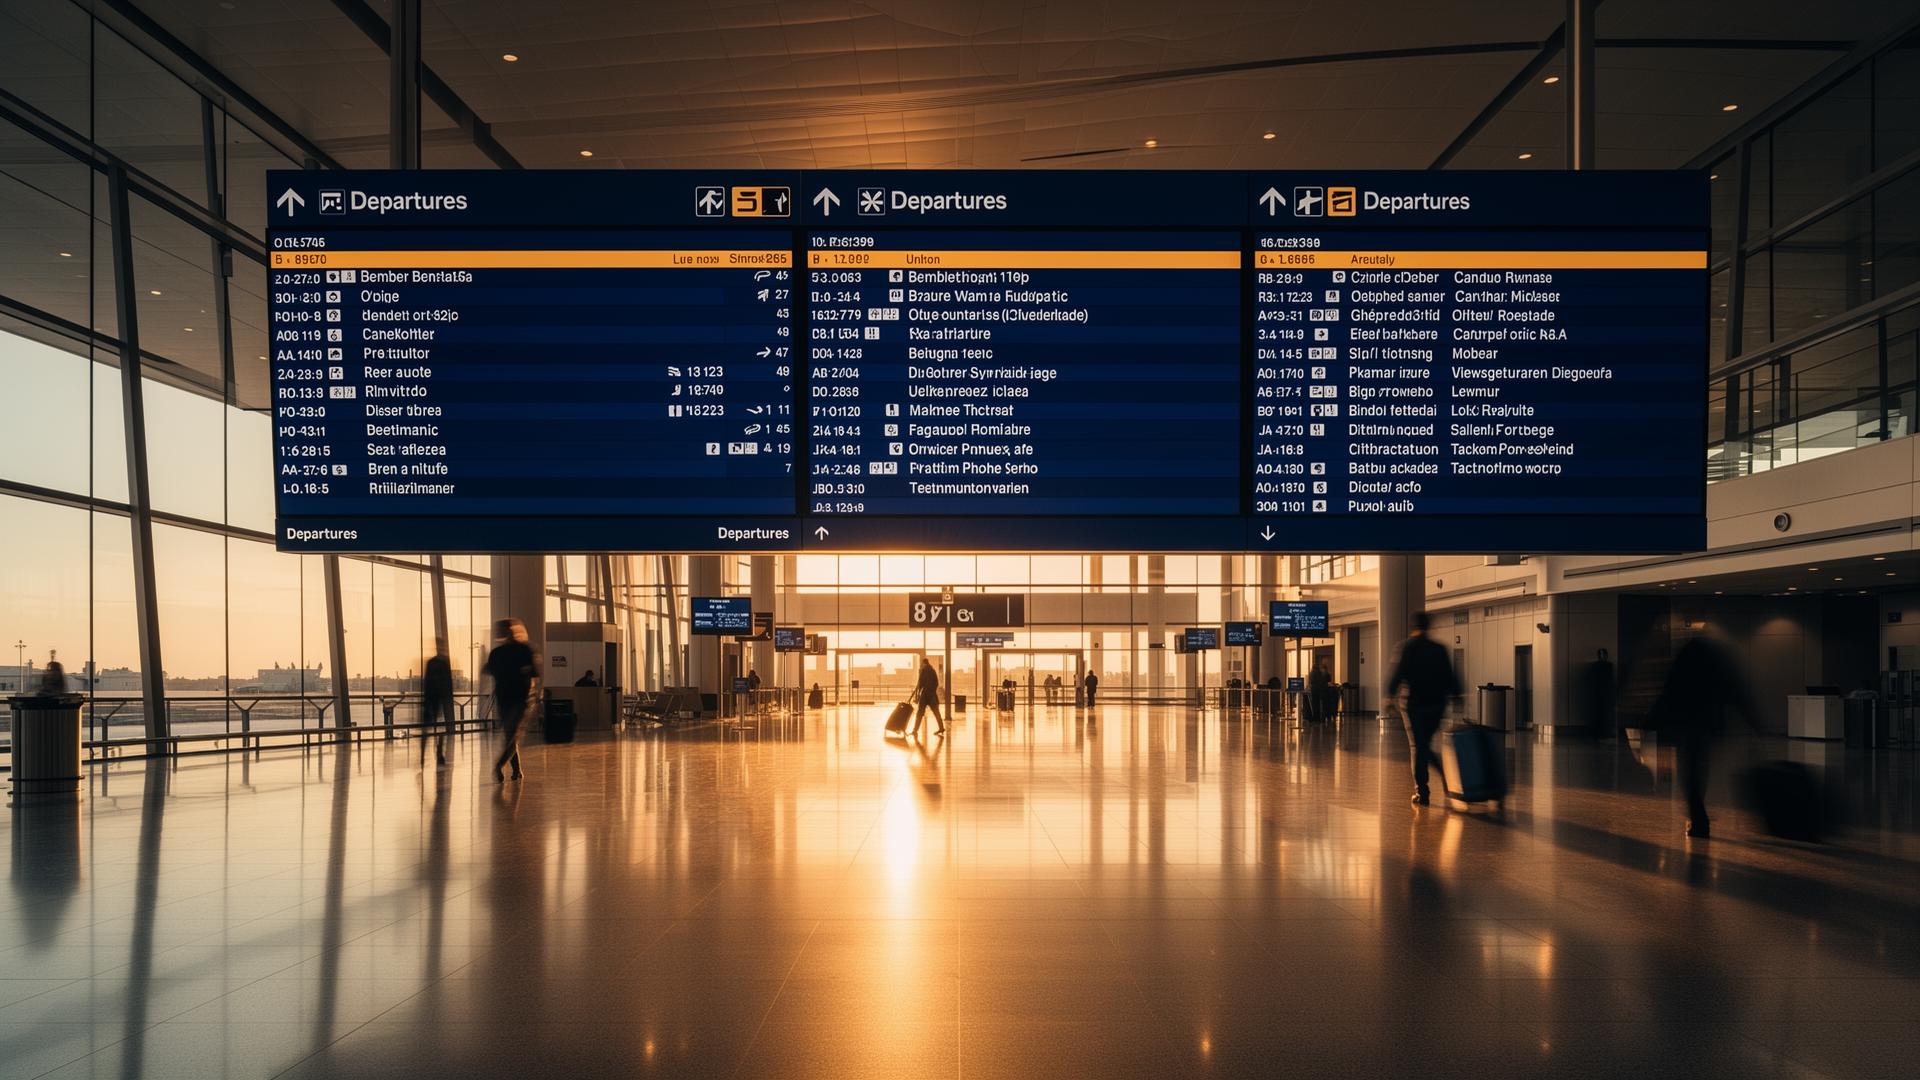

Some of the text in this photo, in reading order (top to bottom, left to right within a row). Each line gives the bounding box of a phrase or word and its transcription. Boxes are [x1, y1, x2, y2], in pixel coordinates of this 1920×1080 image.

[351, 191, 467, 213] Departures
[892, 191, 1006, 214] Departures
[1365, 192, 1470, 214] Departures
[361, 270, 409, 282] Bember
[776, 289, 788, 299] 27
[776, 348, 788, 357] 47
[1453, 347, 1498, 359] Mobear
[365, 367, 392, 378] Reer
[704, 366, 723, 377] 123
[1452, 386, 1499, 397] Lewmur
[369, 463, 397, 474] Bren
[401, 465, 407, 474] a
[786, 464, 791, 472] 7
[287, 528, 357, 541] Departures
[719, 527, 789, 541] Departures
